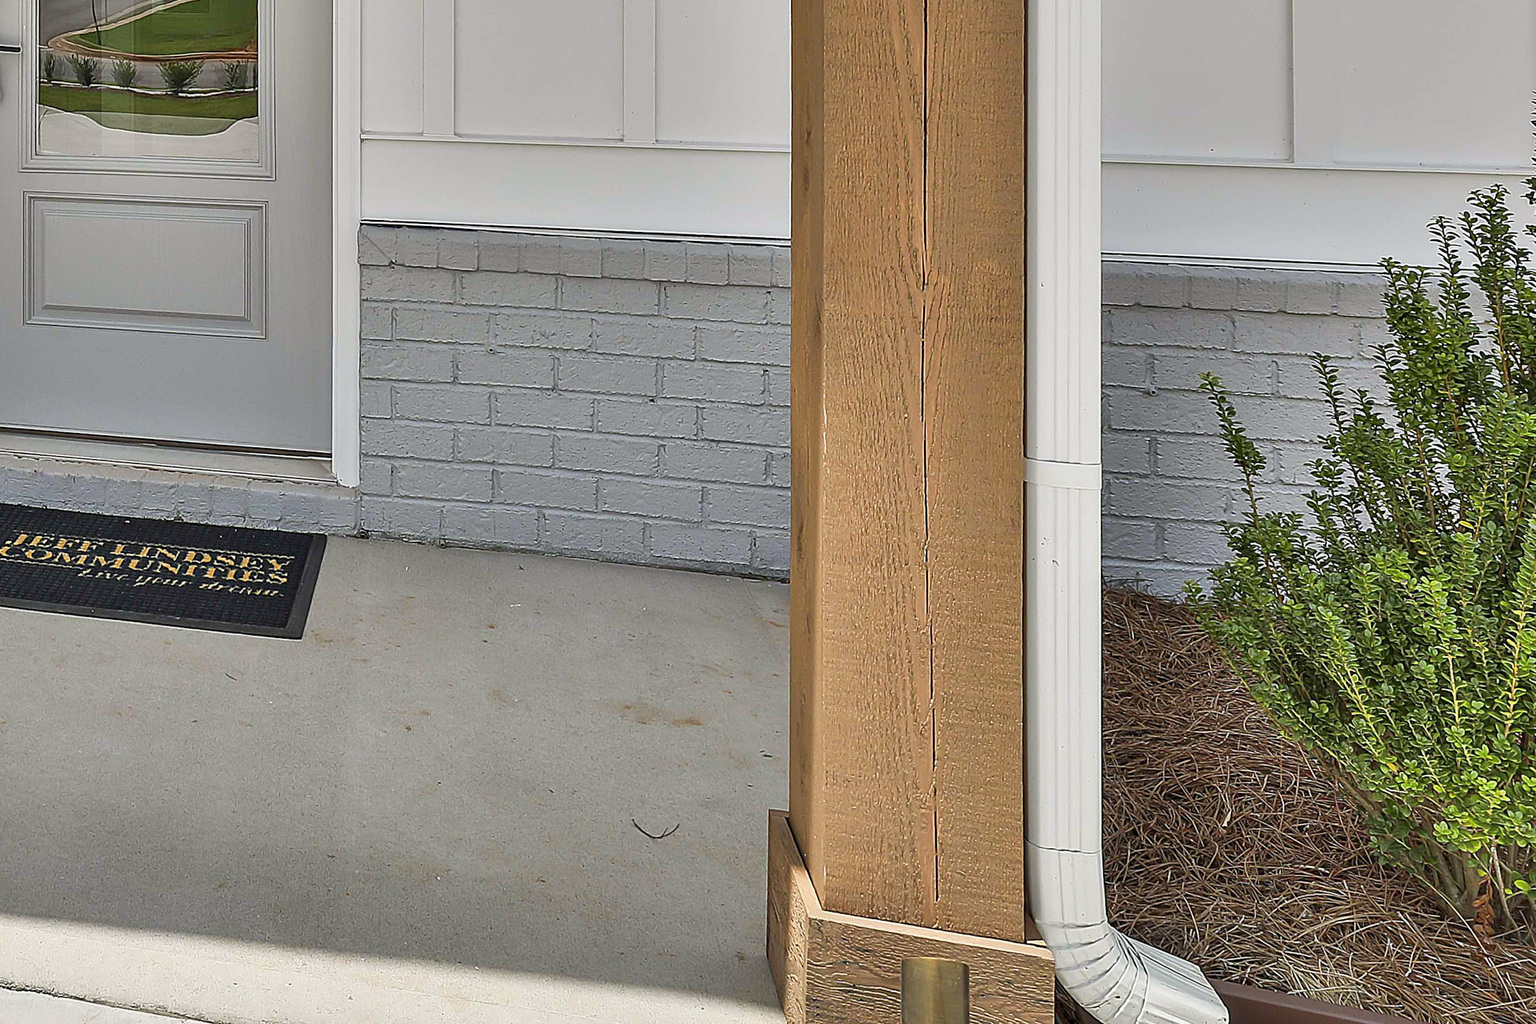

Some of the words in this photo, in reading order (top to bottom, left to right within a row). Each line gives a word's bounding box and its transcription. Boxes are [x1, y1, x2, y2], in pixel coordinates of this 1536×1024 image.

[5, 534, 105, 553] JEFF
[110, 543, 292, 572] LINDSEY
[77, 569, 129, 581] Live
